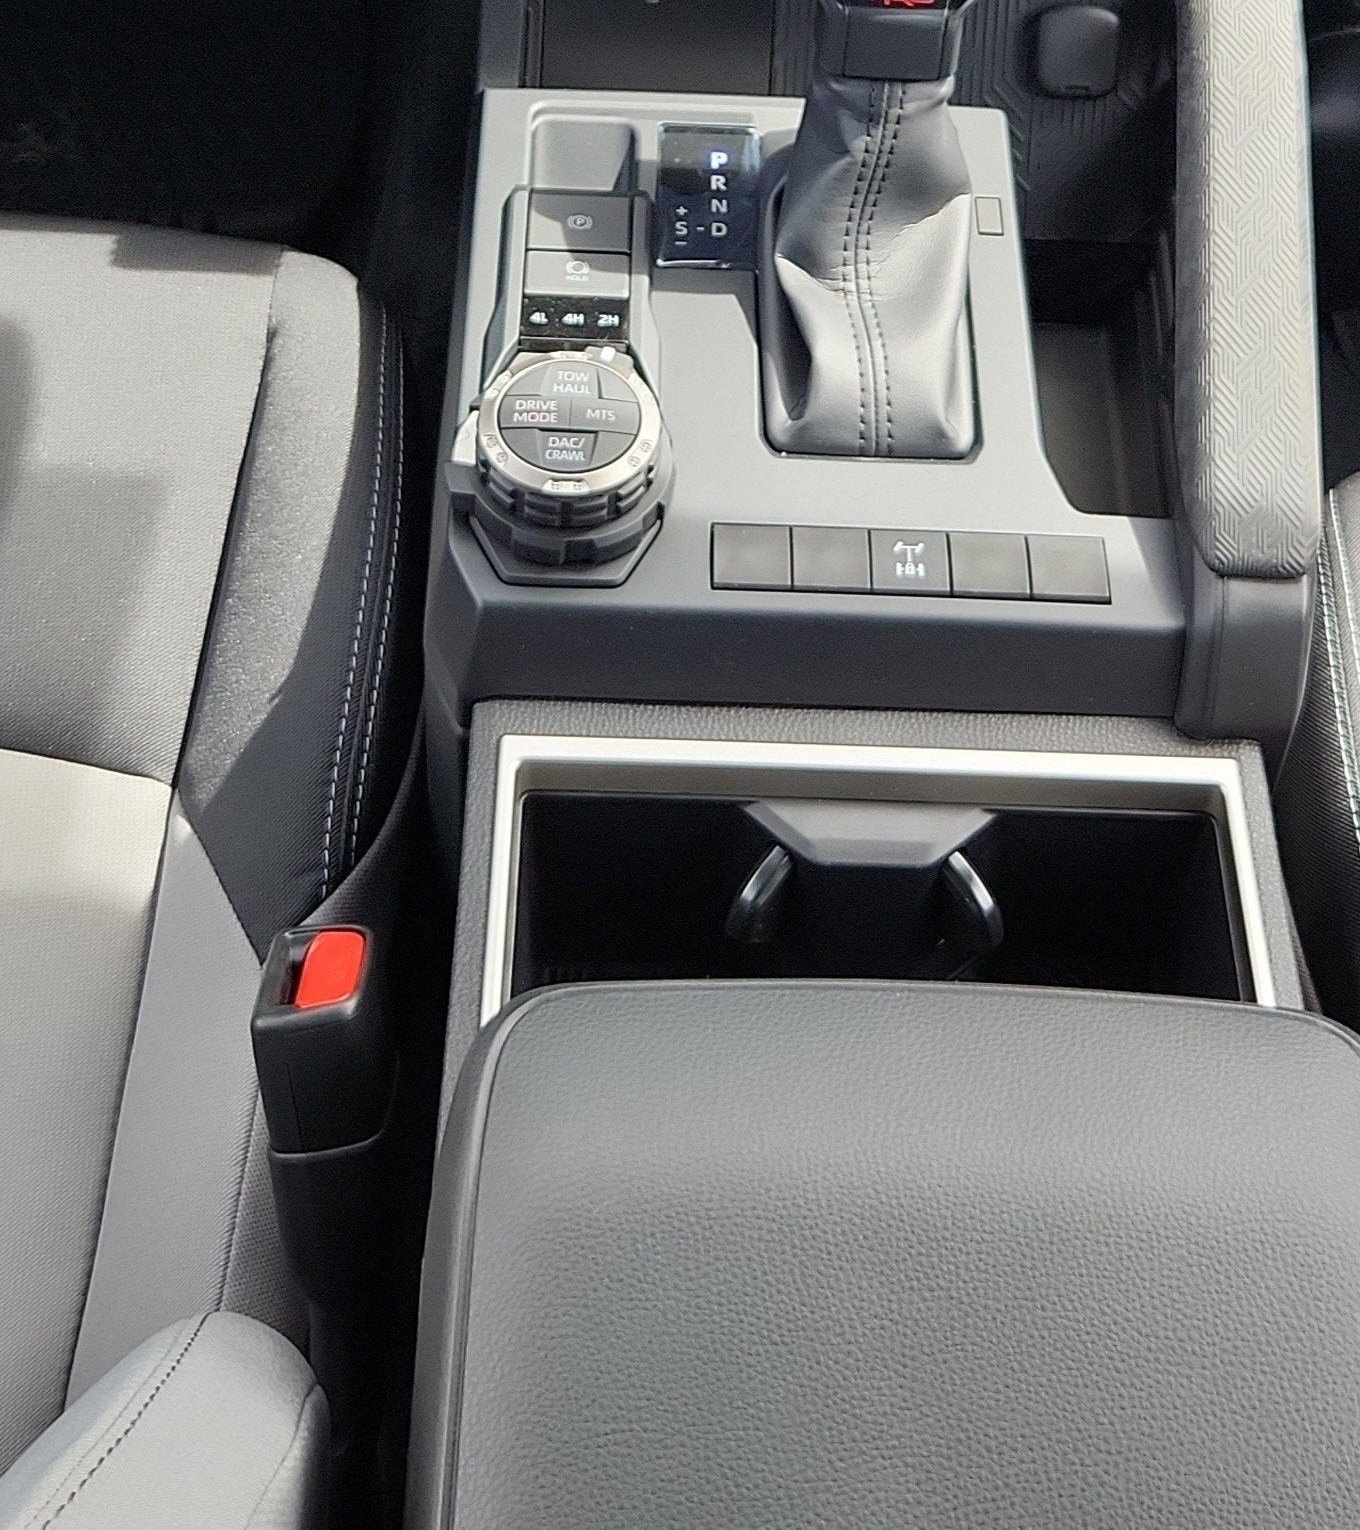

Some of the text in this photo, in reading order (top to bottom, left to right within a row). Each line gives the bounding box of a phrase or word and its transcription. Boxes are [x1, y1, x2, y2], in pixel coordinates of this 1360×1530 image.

[710, 151, 729, 170] P
[710, 174, 727, 191] R
[711, 198, 728, 214] N
[675, 221, 728, 237] S D
[529, 311, 620, 327] 4L 4H 2H
[557, 370, 590, 382] TOW
[553, 382, 592, 395] HAUL
[515, 399, 559, 411] DRIVE
[513, 411, 559, 423] MODE
[586, 408, 617, 421] MTS
[548, 436, 586, 449] DAC/
[544, 449, 587, 461] CRAWL
